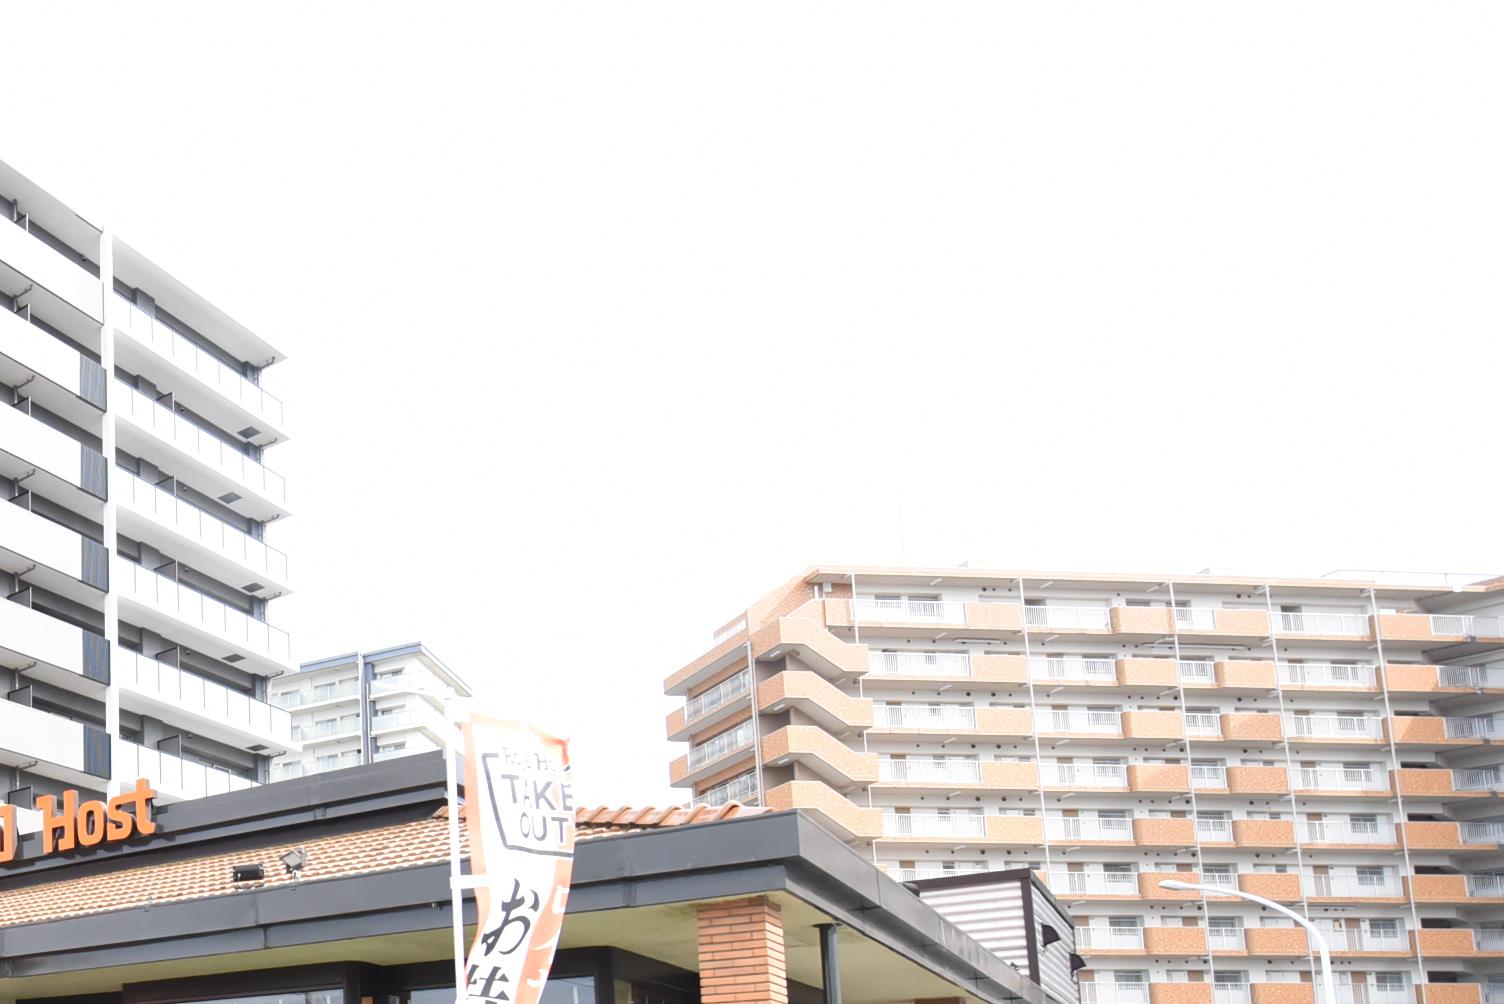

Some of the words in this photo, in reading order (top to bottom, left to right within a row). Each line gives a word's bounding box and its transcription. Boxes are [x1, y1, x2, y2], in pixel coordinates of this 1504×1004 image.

[501, 774, 573, 811] TAKE
[35, 777, 158, 854] Host
[520, 812, 569, 843] OUT
